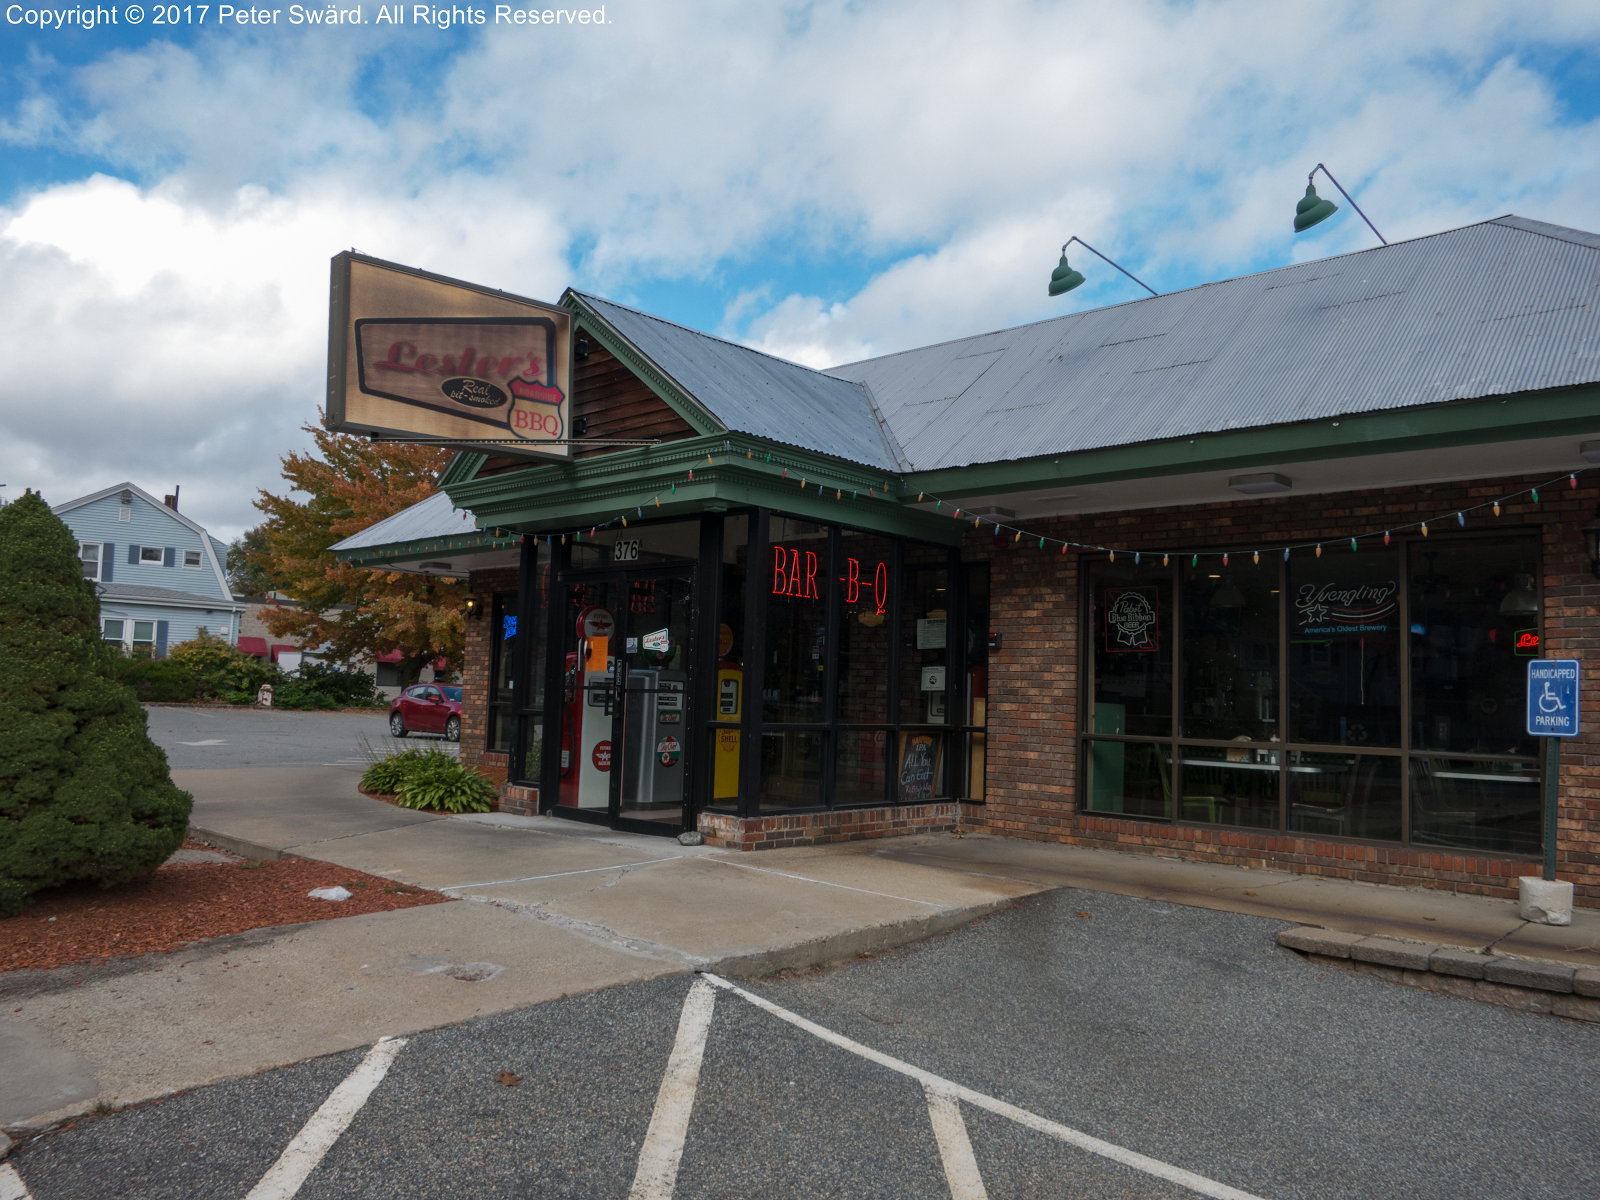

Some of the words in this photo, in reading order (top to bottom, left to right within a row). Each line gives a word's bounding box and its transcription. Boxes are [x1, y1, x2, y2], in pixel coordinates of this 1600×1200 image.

[373, 341, 544, 377] Lester's
[462, 379, 491, 396] Real
[519, 387, 557, 403] ROADSIDE
[514, 409, 559, 436] BBQ
[615, 540, 638, 560] 376
[772, 546, 819, 600] BAR
[1295, 580, 1397, 609] Yuengling
[1119, 600, 1144, 613] Pabst
[1111, 612, 1127, 622] Blue
[1127, 612, 1153, 622] Ribbon
[1123, 621, 1140, 629] BEER
[1359, 624, 1388, 632] Brewery
[1531, 668, 1576, 679] HANDICAPPED
[1535, 715, 1570, 727] PARKING
[720, 735, 738, 743] SHELL
[900, 771, 915, 785] Can
[916, 767, 934, 780] Eat
